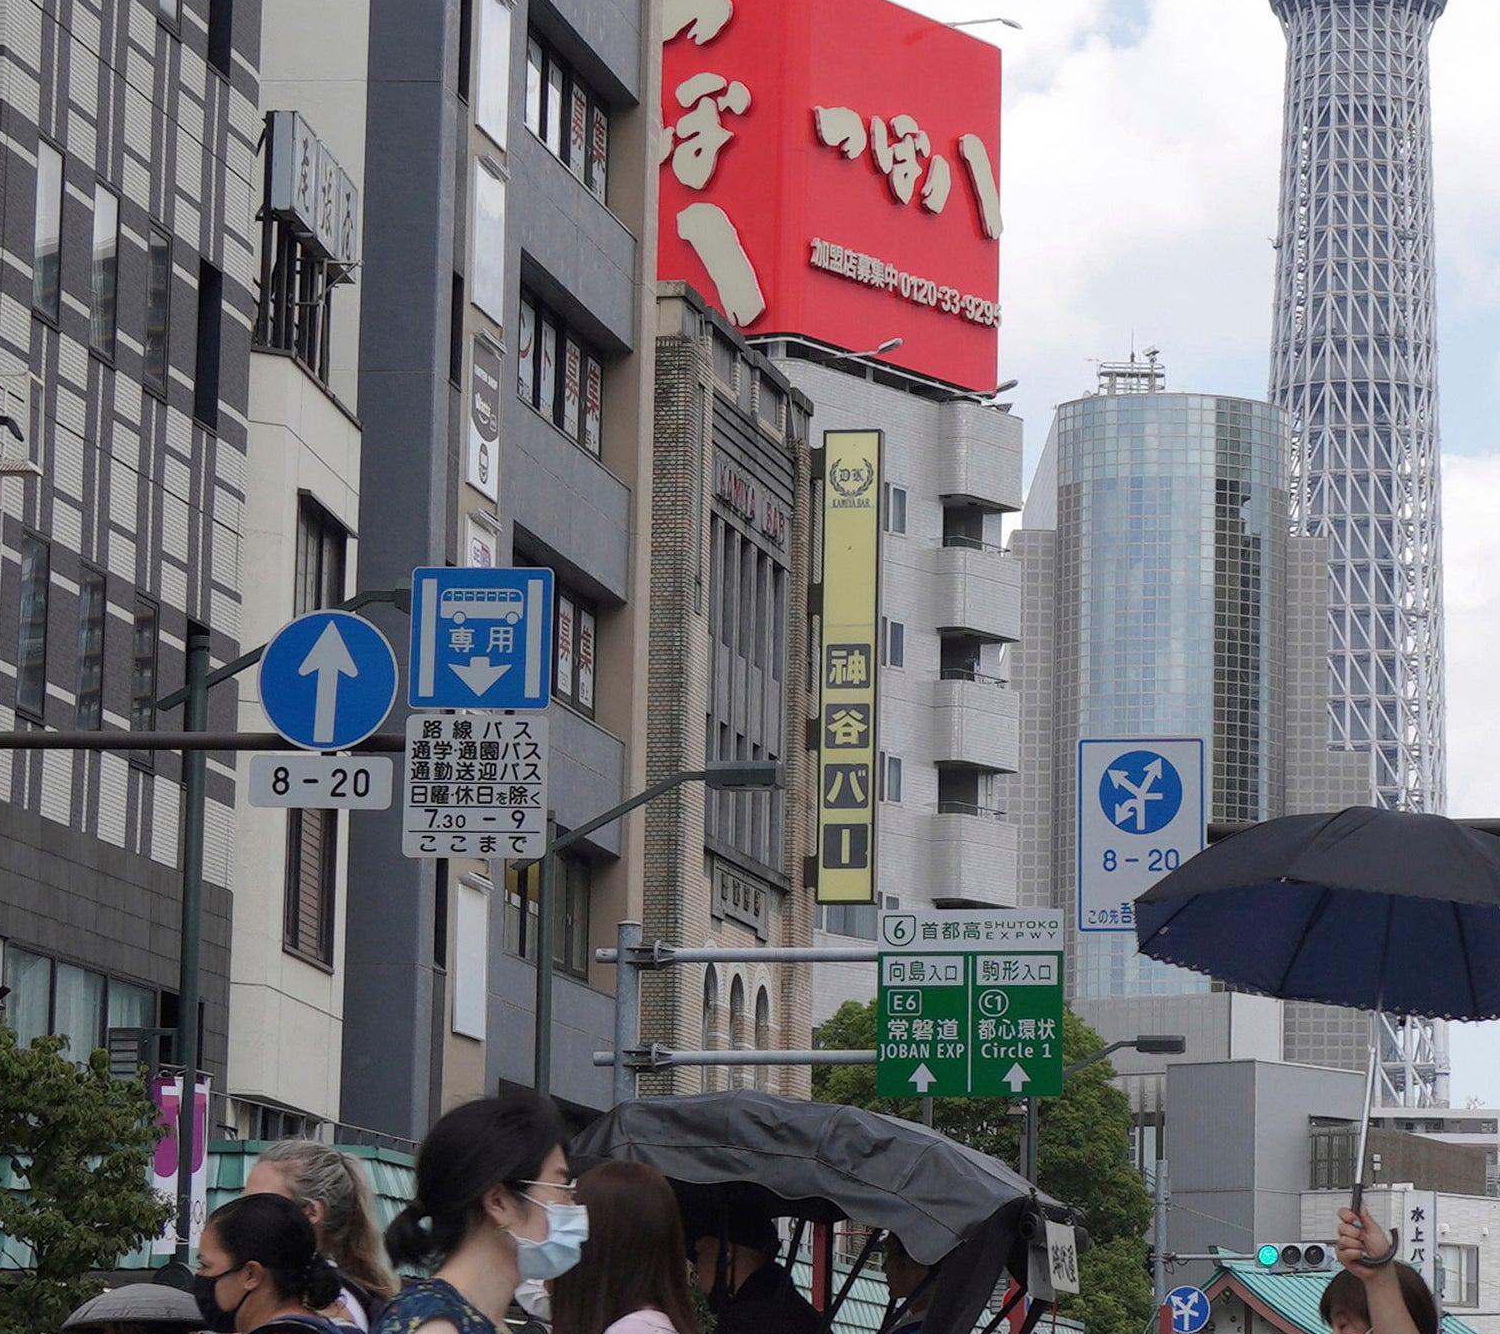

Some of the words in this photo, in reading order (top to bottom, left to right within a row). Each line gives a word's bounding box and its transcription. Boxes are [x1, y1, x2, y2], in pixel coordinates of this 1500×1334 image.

[814, 104, 1003, 242] つぼ八
[809, 236, 899, 289] 加盟店募集中
[899, 272, 1003, 328] 0120-33-9295
[717, 462, 756, 519] KAMIYA
[764, 503, 787, 545] BAR
[448, 625, 515, 654] 専用
[421, 719, 533, 741] 路線バス
[410, 740, 542, 762] 通学・通園バス
[826, 649, 869, 865] 神谷バー
[410, 761, 542, 782] 通勤送迎バス
[410, 785, 541, 807] 日曜・休日を除く
[419, 834, 528, 855] ここまで
[1088, 901, 1134, 925] この先吾
[893, 920, 906, 940] 6
[920, 921, 981, 941] 首都高
[983, 920, 1059, 930] SHUTOKO
[985, 931, 1056, 940] EXPWY
[889, 959, 958, 982] 向島入口
[982, 959, 1051, 982] 駒形入口
[893, 994, 917, 1011] E6
[983, 994, 1002, 1012] C1
[887, 1018, 959, 1041] 常磐道
[978, 1018, 1056, 1041] 都心環状
[880, 1043, 930, 1062] JOBAN
[937, 1043, 966, 1059] EXP
[981, 1042, 1034, 1059] Circle
[1042, 1043, 1052, 1059] 1
[1410, 1206, 1426, 1275] 水上バ
